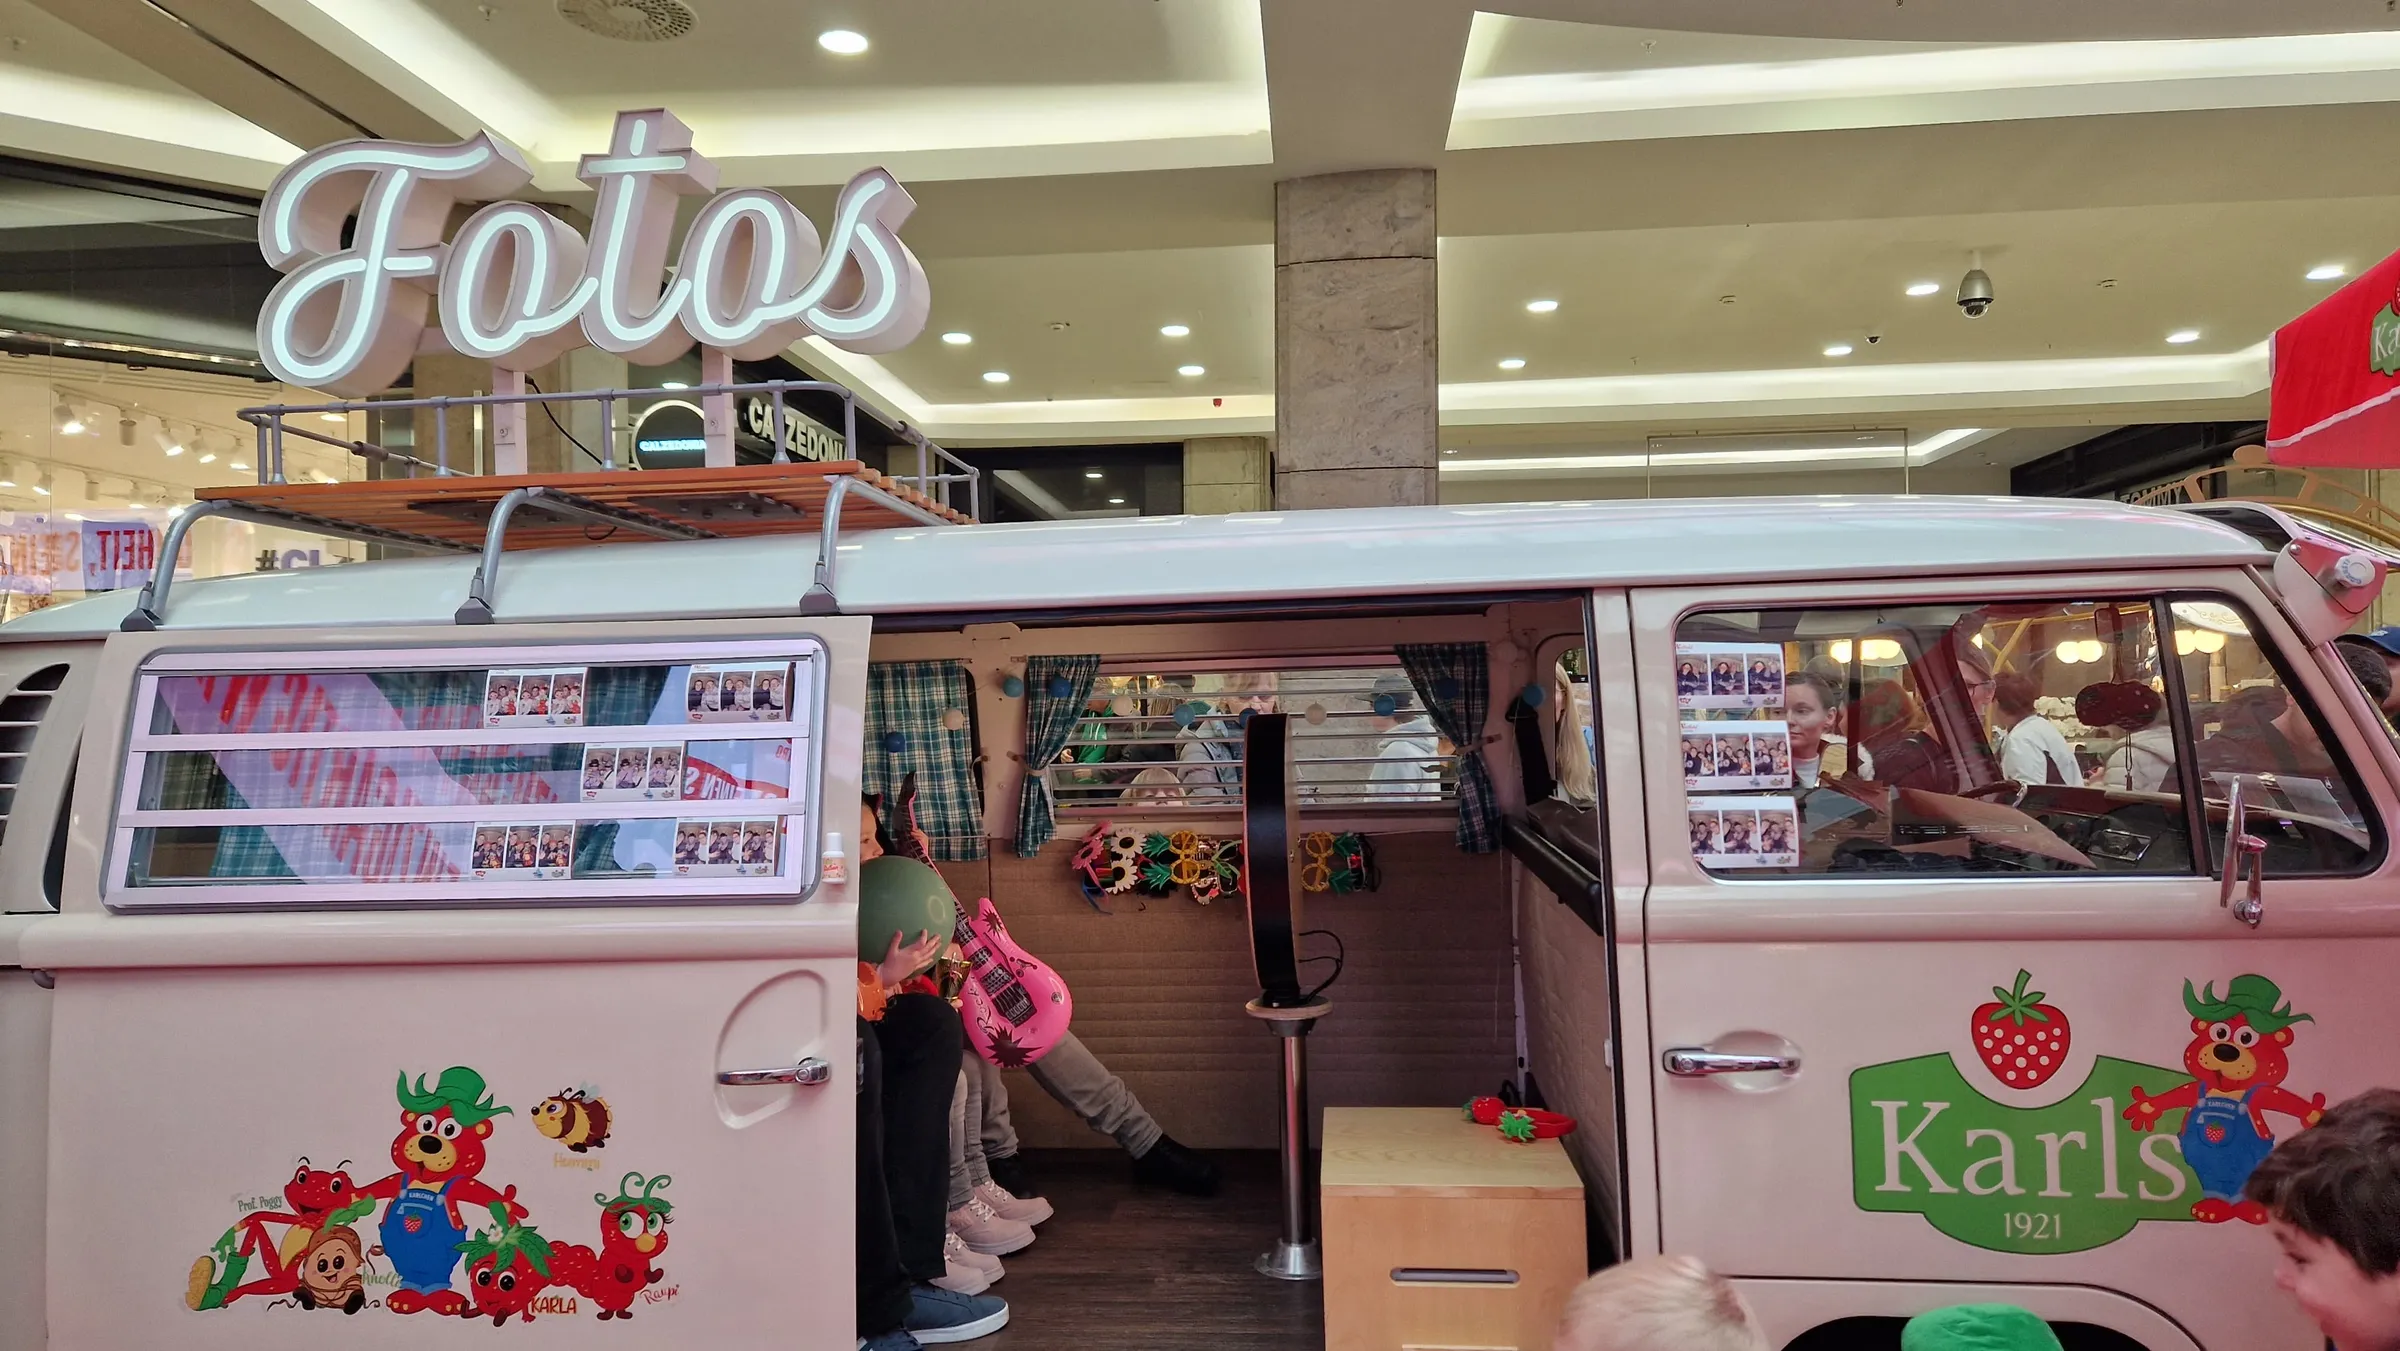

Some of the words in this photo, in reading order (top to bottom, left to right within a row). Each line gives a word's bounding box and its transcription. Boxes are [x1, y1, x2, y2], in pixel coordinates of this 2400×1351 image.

[257, 108, 930, 396] Fotos
[748, 397, 848, 462] CAZEDONI
[1870, 1097, 2188, 1203] Karls
[2003, 1212, 2061, 1239] 1921
[531, 1296, 577, 1314] KARLA
[640, 1284, 679, 1305] Raupi
